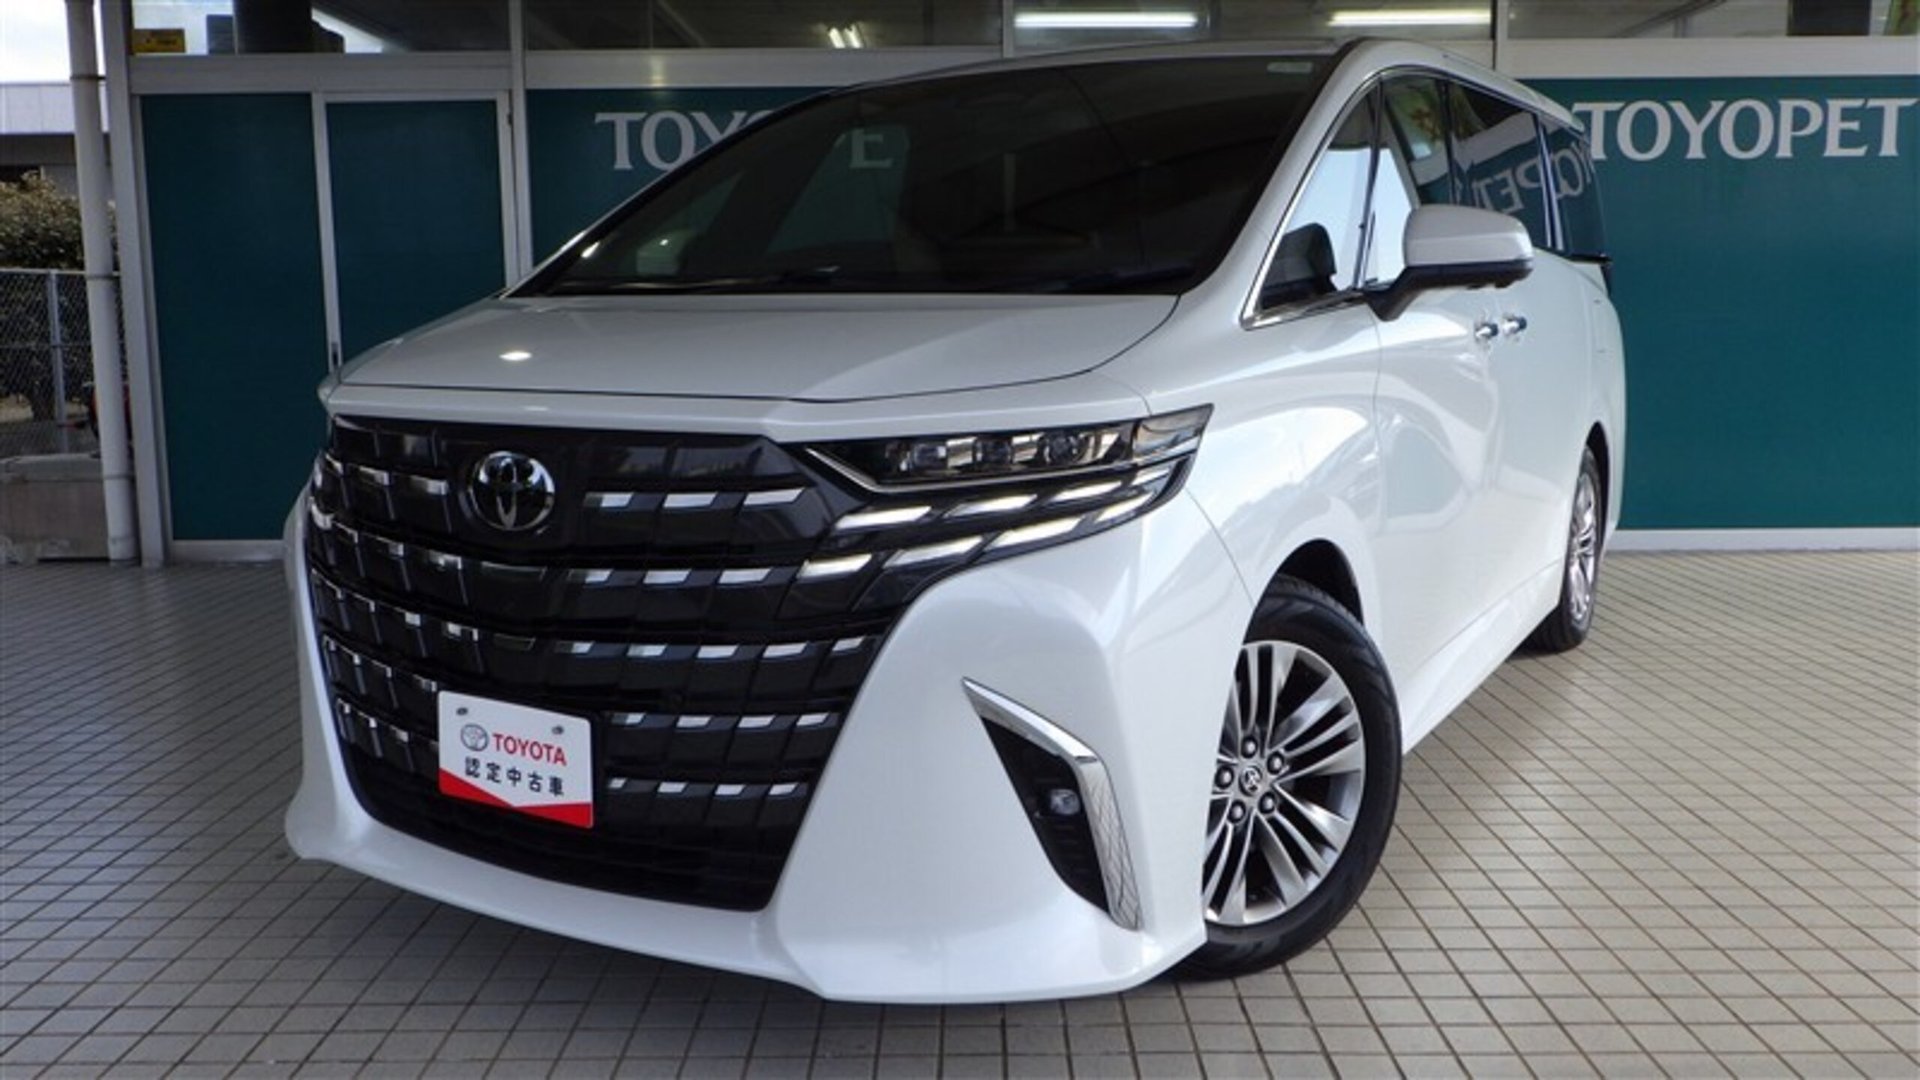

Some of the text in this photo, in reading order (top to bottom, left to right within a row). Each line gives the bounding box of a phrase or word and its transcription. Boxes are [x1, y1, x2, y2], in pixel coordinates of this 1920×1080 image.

[1572, 98, 1918, 161] TOYOPET
[493, 733, 567, 766] TOYOTA
[465, 757, 564, 796] 認定中古車
